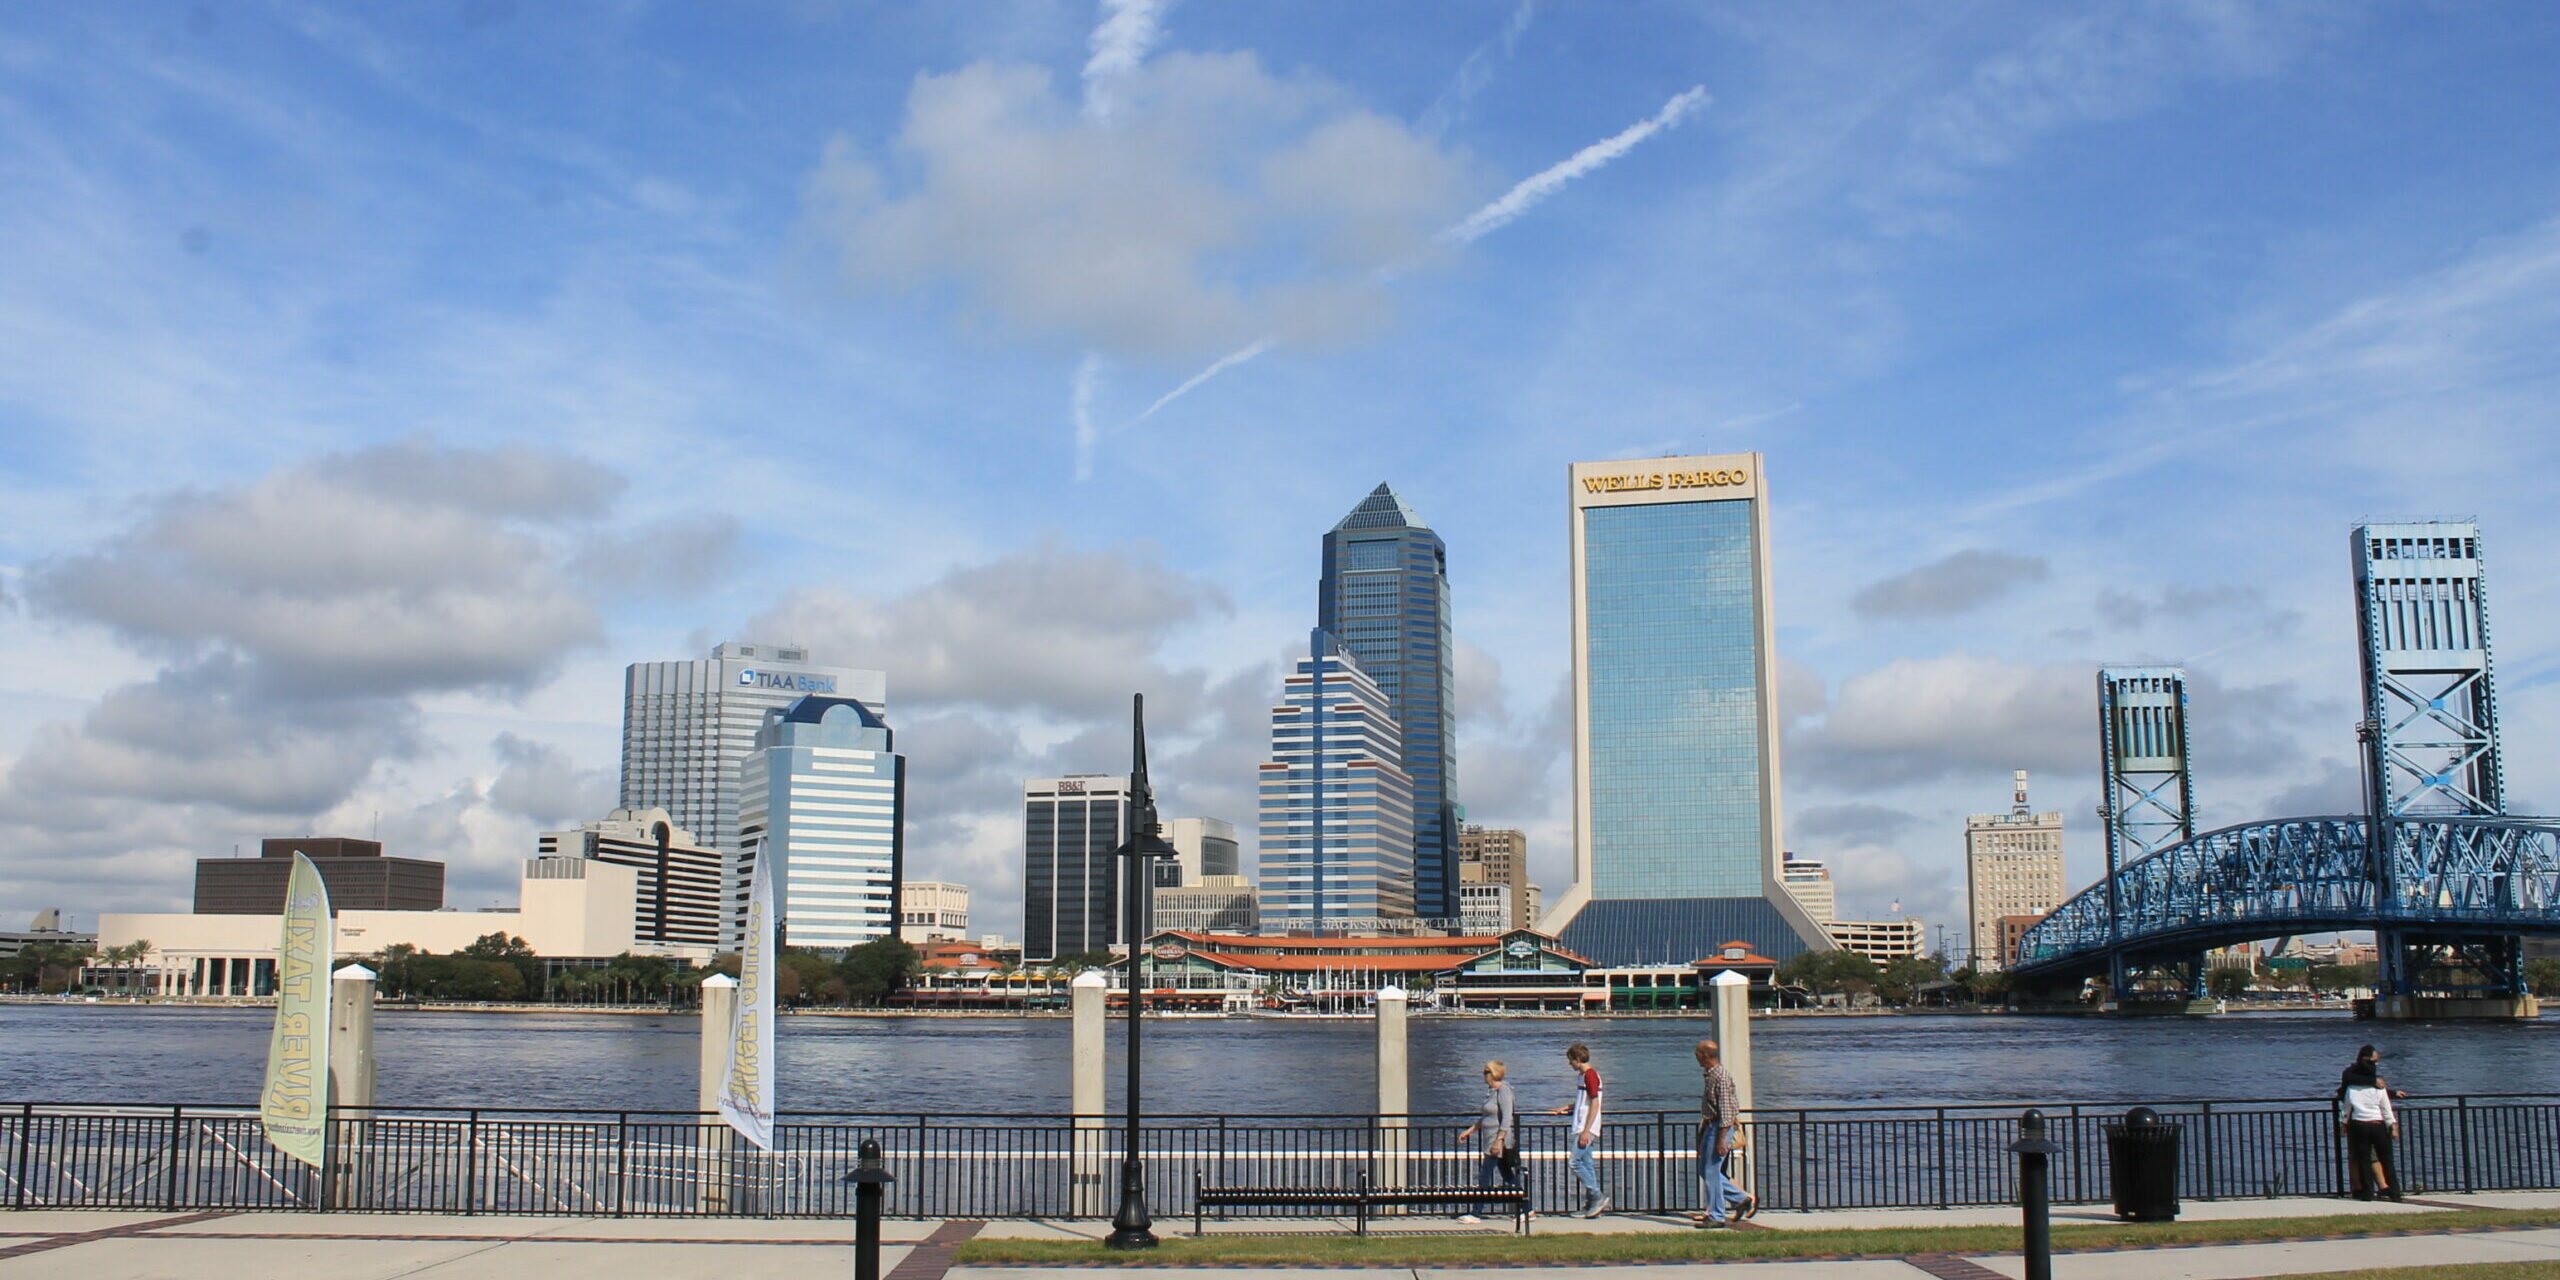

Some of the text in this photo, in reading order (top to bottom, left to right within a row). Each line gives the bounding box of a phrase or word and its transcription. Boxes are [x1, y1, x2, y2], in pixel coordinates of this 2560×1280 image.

[1583, 468, 1748, 493] WELLS FARGO
[757, 673, 834, 693] TIAA Bank
[1058, 781, 1086, 791] BB&T
[1281, 919, 1306, 930] THE
[1322, 919, 1429, 930] JACKSONVILLE
